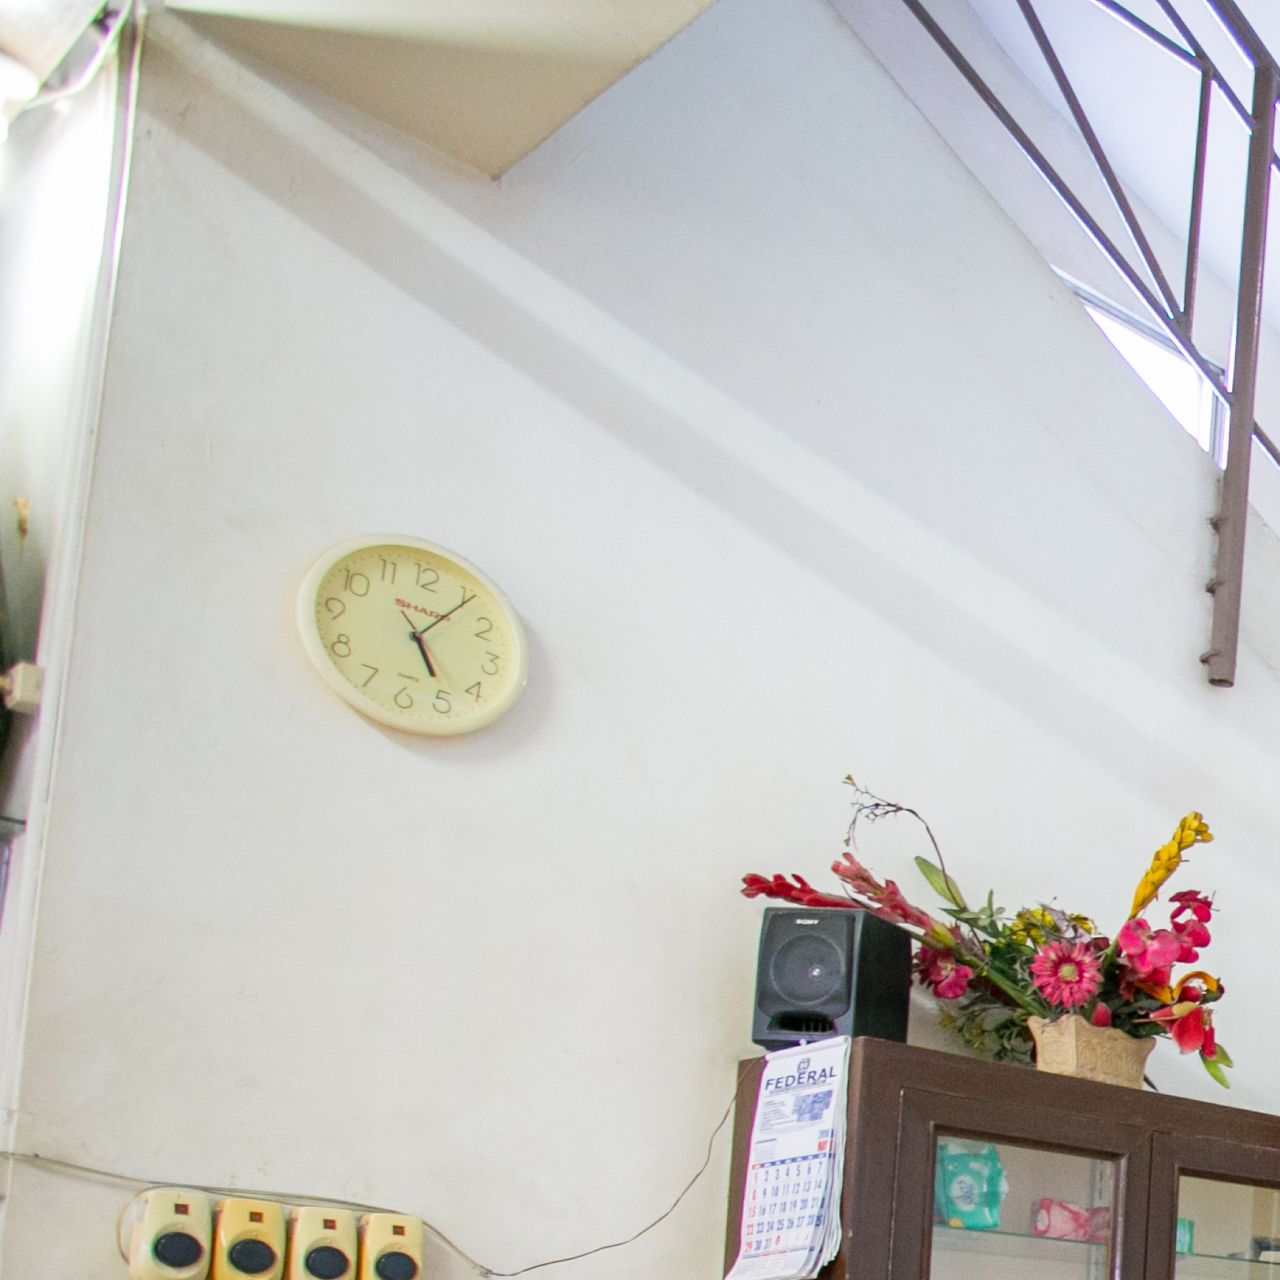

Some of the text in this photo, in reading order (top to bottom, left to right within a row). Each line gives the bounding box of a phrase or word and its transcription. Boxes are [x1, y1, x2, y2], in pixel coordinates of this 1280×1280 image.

[343, 567, 371, 597] 10
[379, 558, 398, 585] 11
[414, 562, 441, 593] 12
[324, 597, 346, 621] 9
[474, 616, 494, 642] 2
[330, 634, 352, 658] 8
[361, 663, 379, 689] 7
[481, 651, 500, 676] 3
[393, 686, 414, 710] 6
[432, 689, 452, 714] 5
[464, 681, 483, 703] 4
[765, 1065, 838, 1091] FEDERAL
